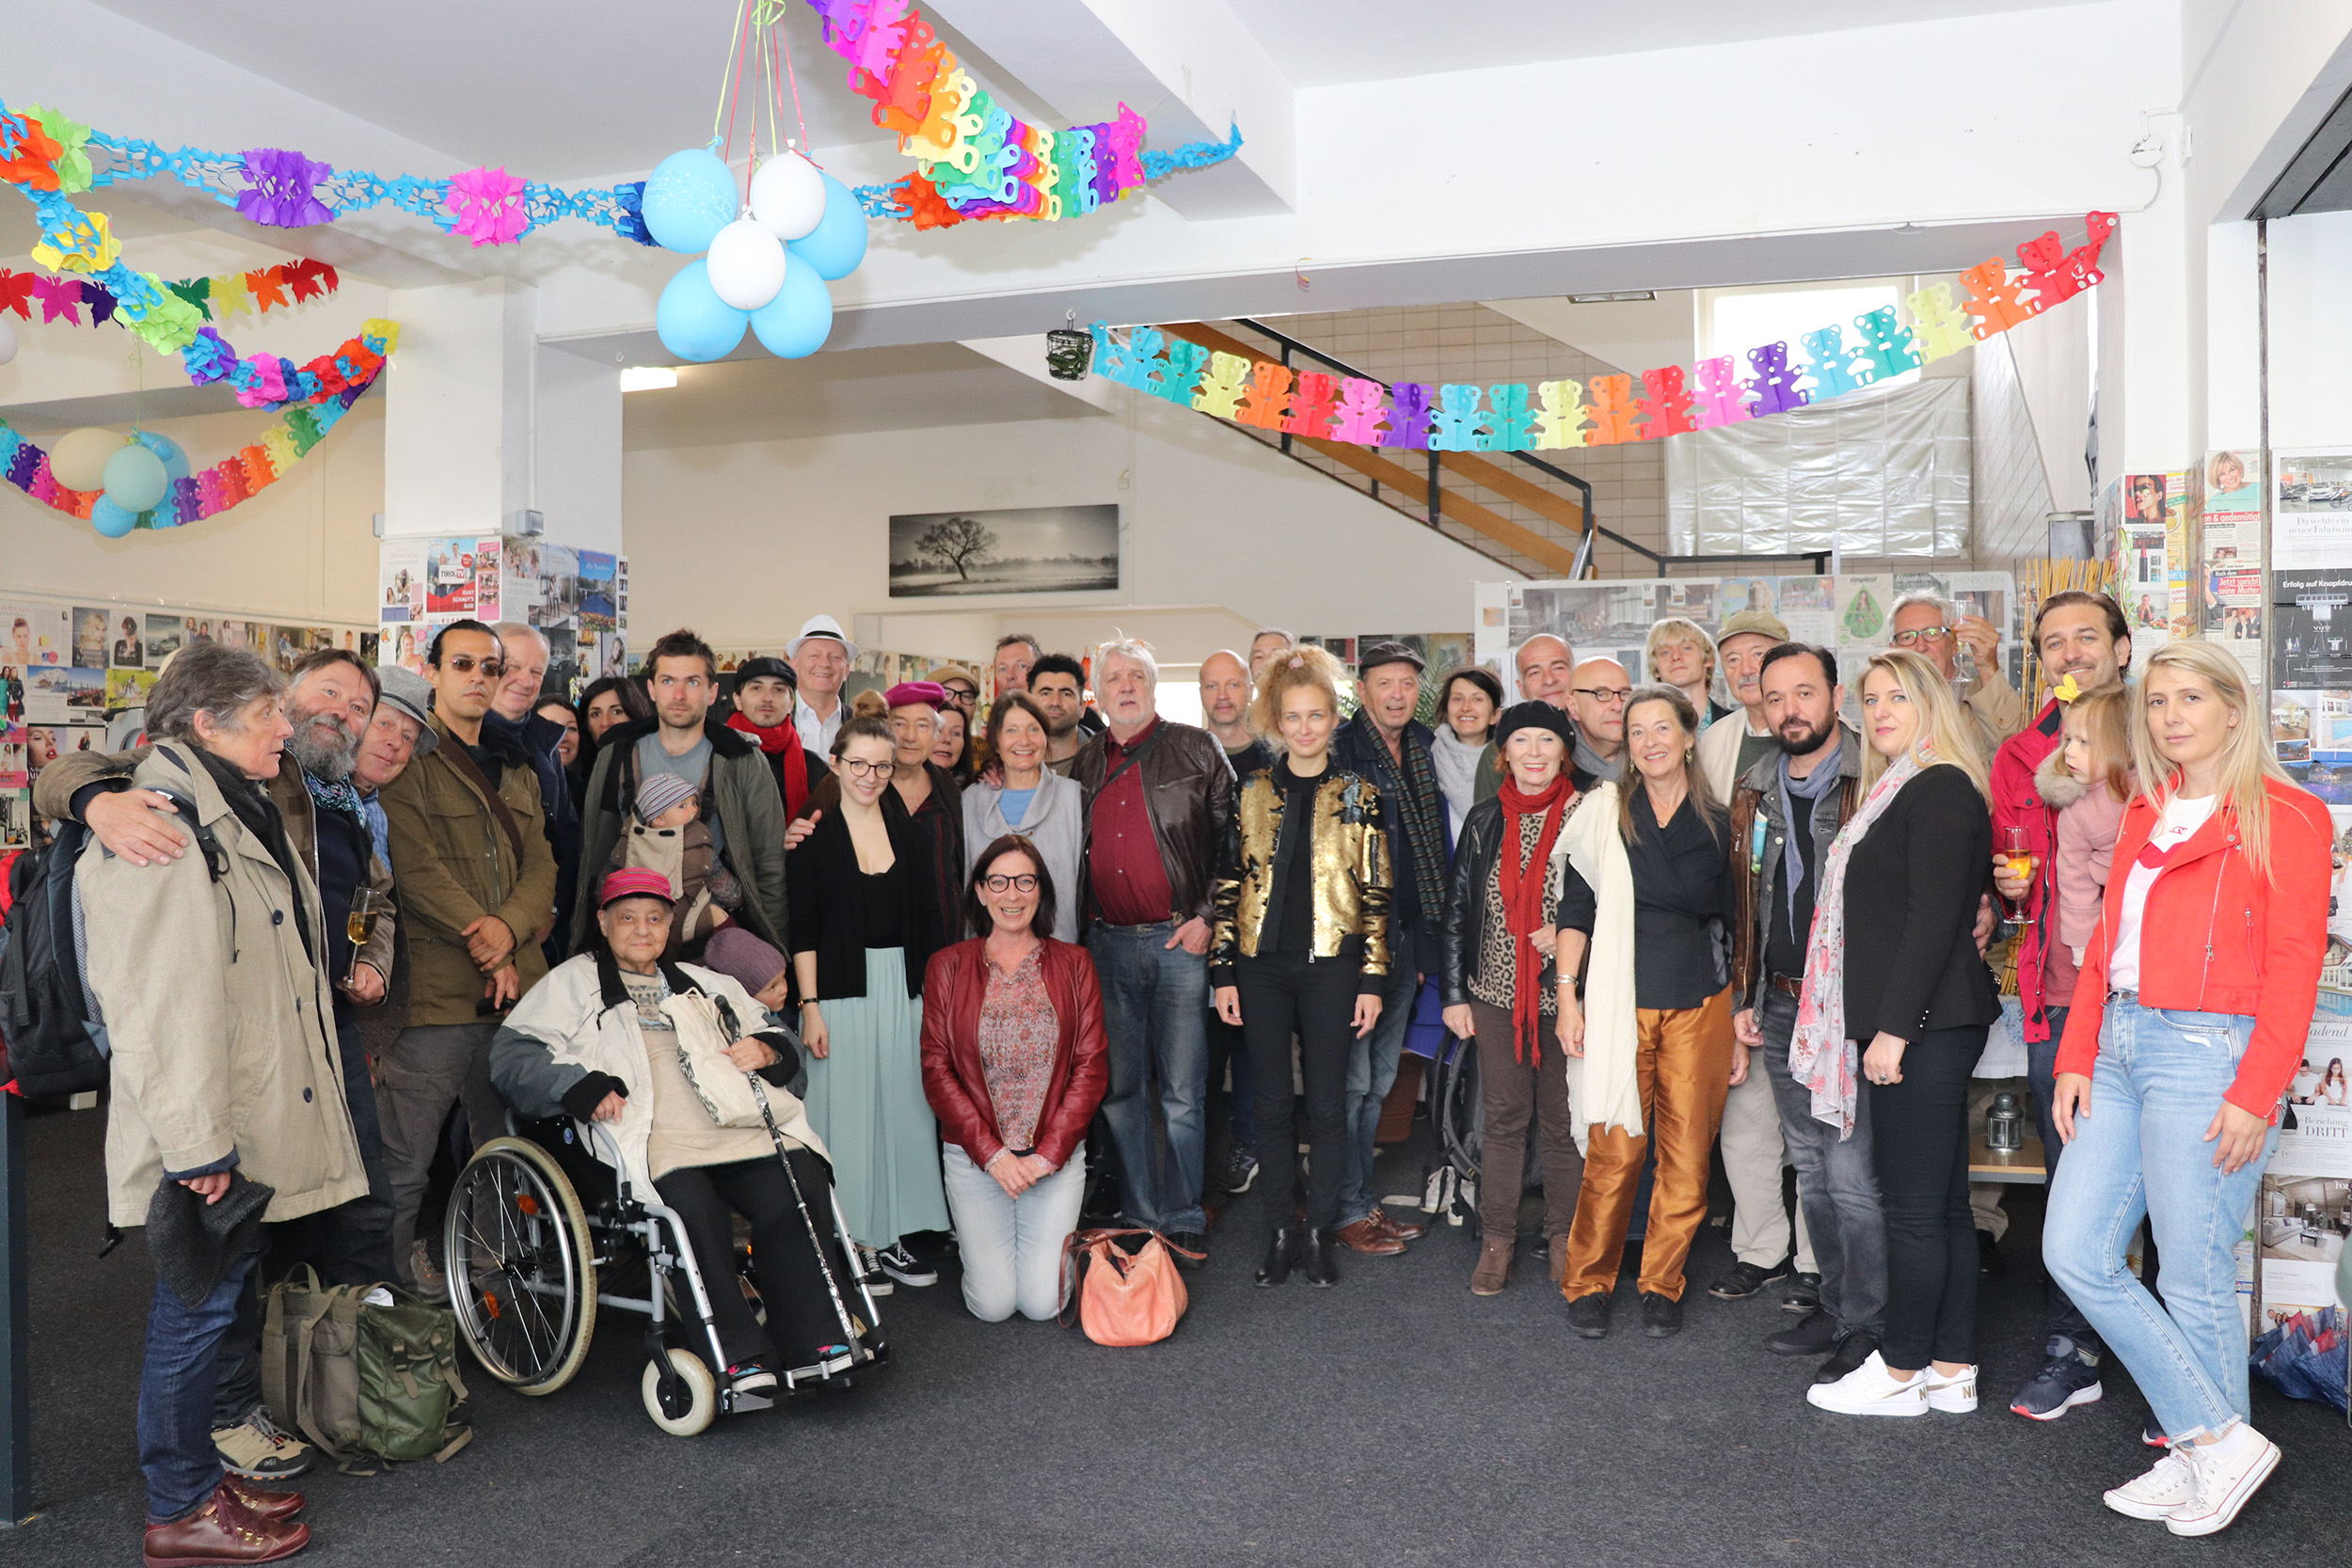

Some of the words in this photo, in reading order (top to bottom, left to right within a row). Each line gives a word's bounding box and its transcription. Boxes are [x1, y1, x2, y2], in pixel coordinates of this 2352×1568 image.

[2213, 514, 2218, 522] &
[2310, 516, 2334, 525] wehte
[1954, 575, 2004, 584] MENSCHEN
[2168, 571, 2185, 579] NEU
[2220, 578, 2235, 586] Jetzt
[2236, 577, 2260, 588] spricht
[2282, 580, 2304, 589] Erfolg
[2218, 586, 2236, 594] seine
[2237, 586, 2260, 594] Mutter
[2305, 1116, 2349, 1128] Beziehung
[2306, 1126, 2348, 1138] DRITT
